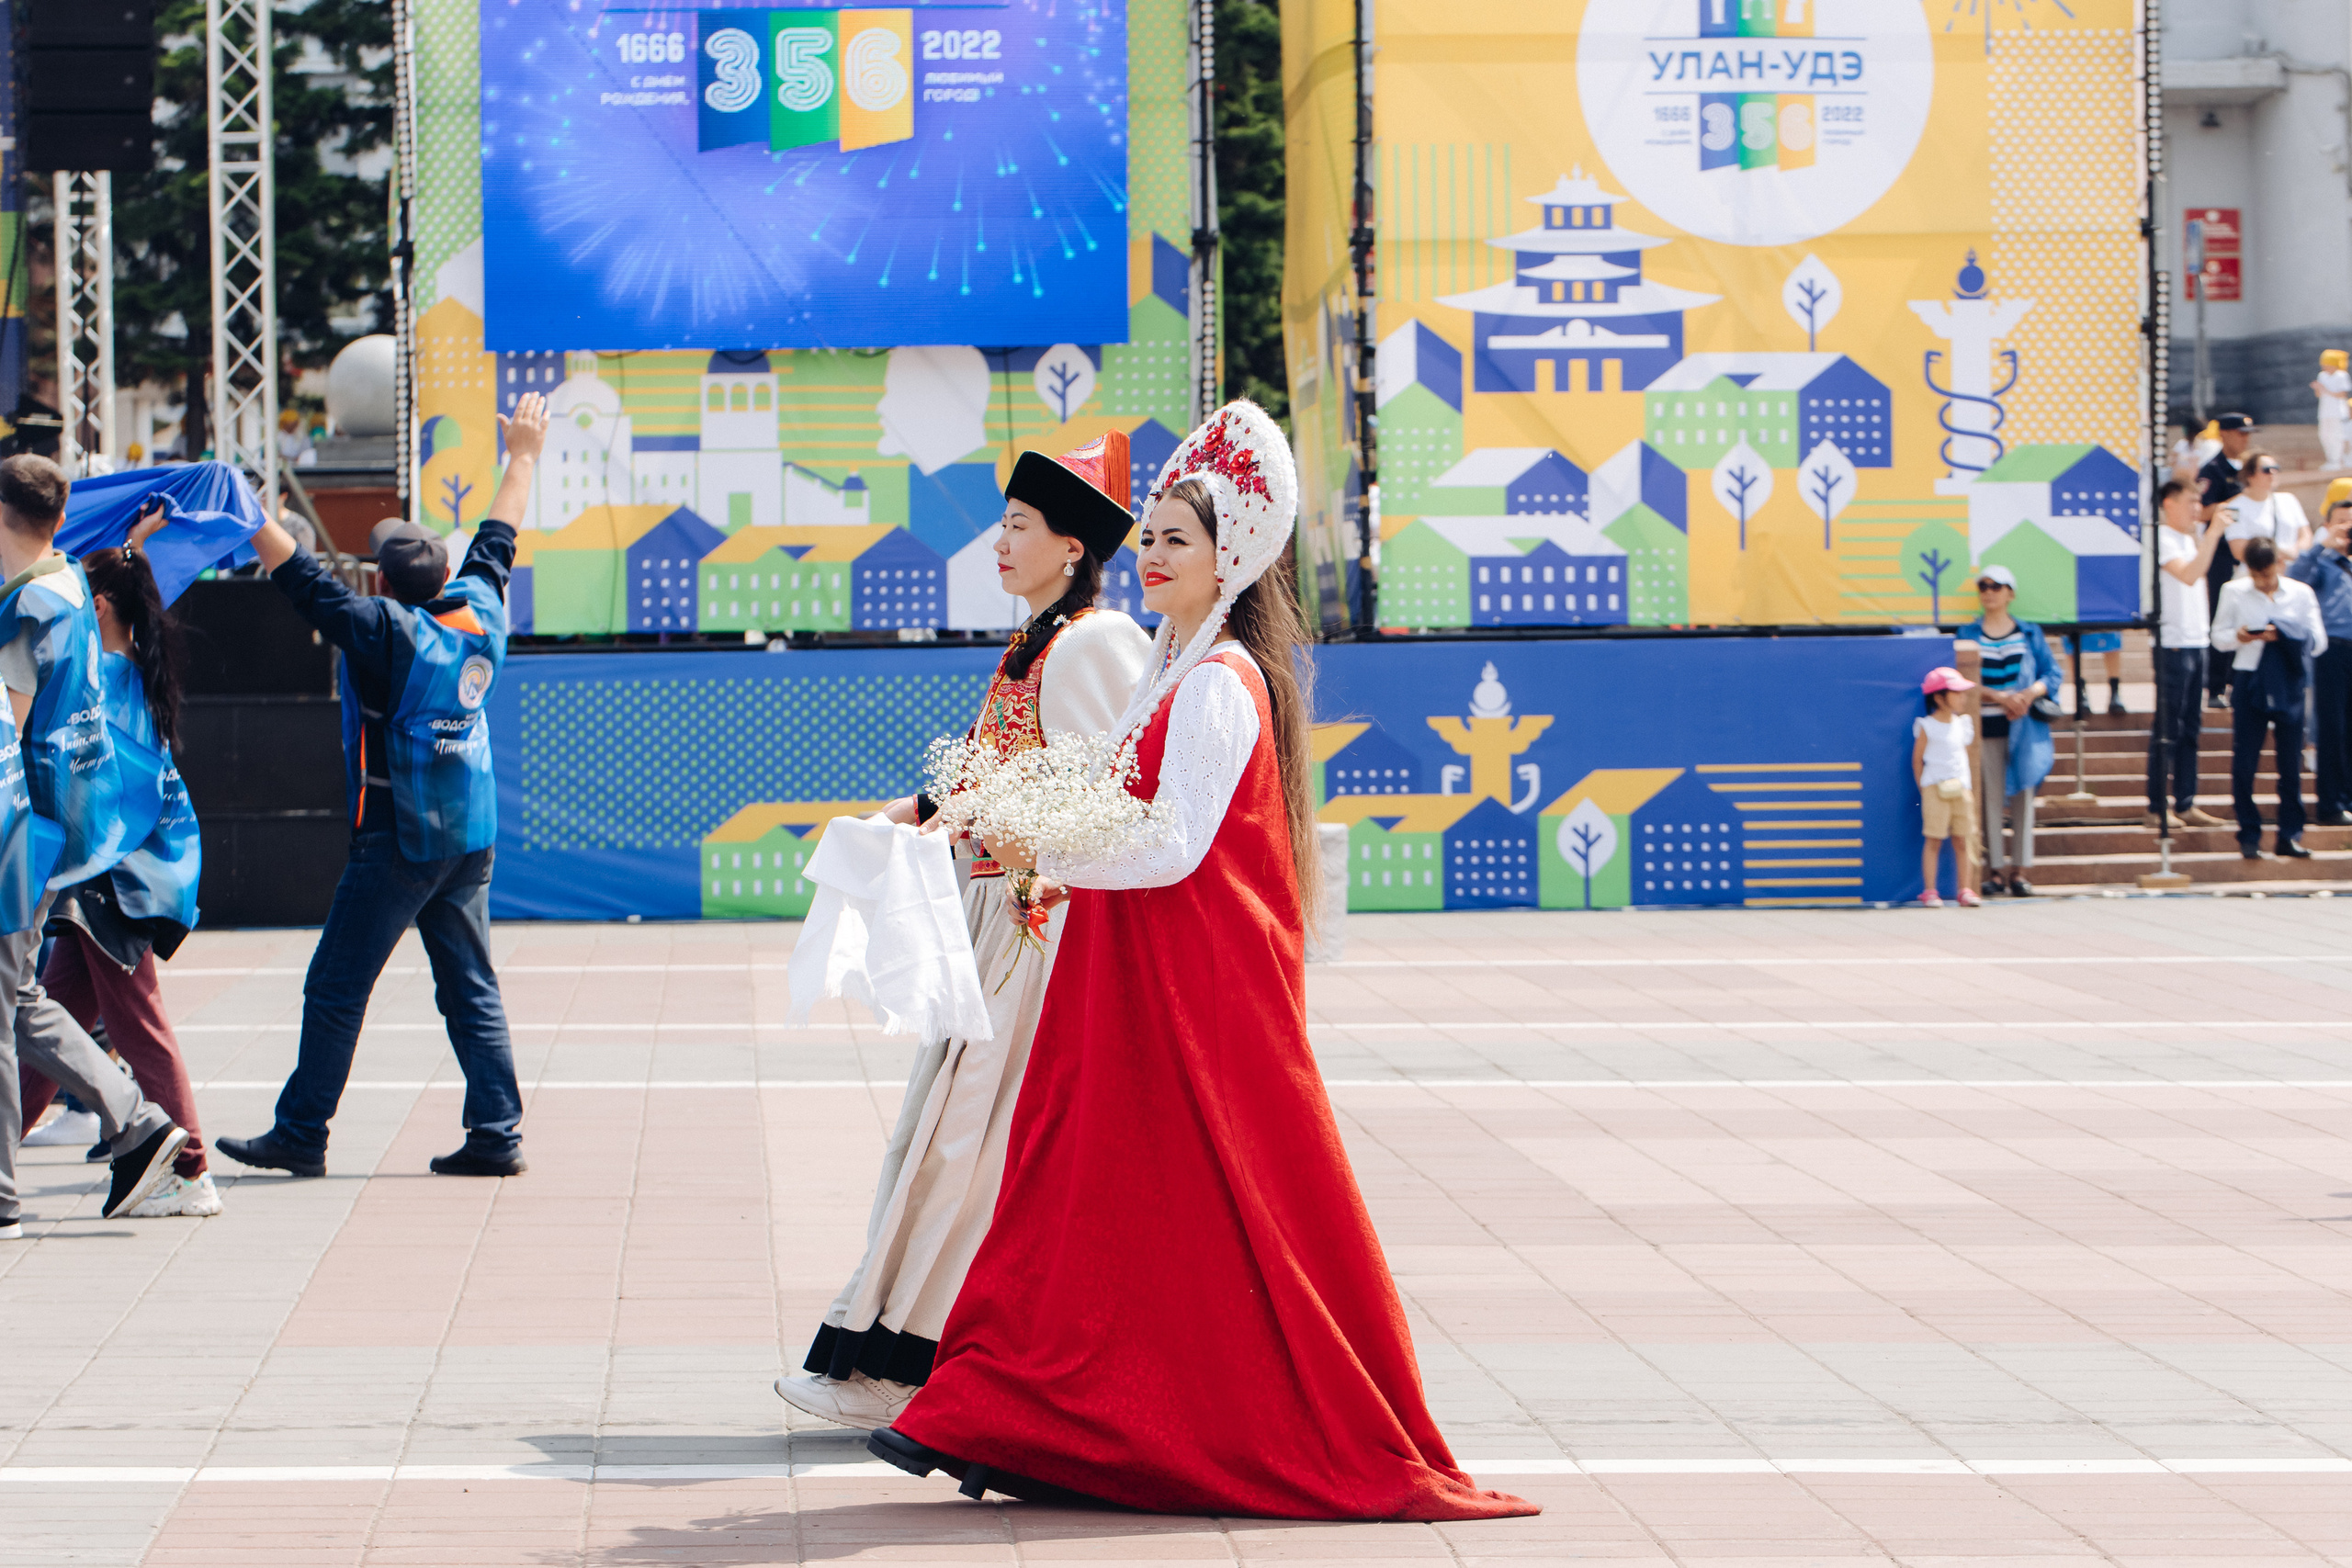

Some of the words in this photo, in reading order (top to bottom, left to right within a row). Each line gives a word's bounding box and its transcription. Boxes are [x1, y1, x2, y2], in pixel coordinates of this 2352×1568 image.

[616, 32, 685, 63] 1666
[921, 29, 1001, 61] 2022
[705, 28, 908, 112] 356
[1649, 50, 1863, 86] УЛАН-УДЭ
[1702, 102, 1815, 152] 356
[1821, 106, 1864, 121] 2022
